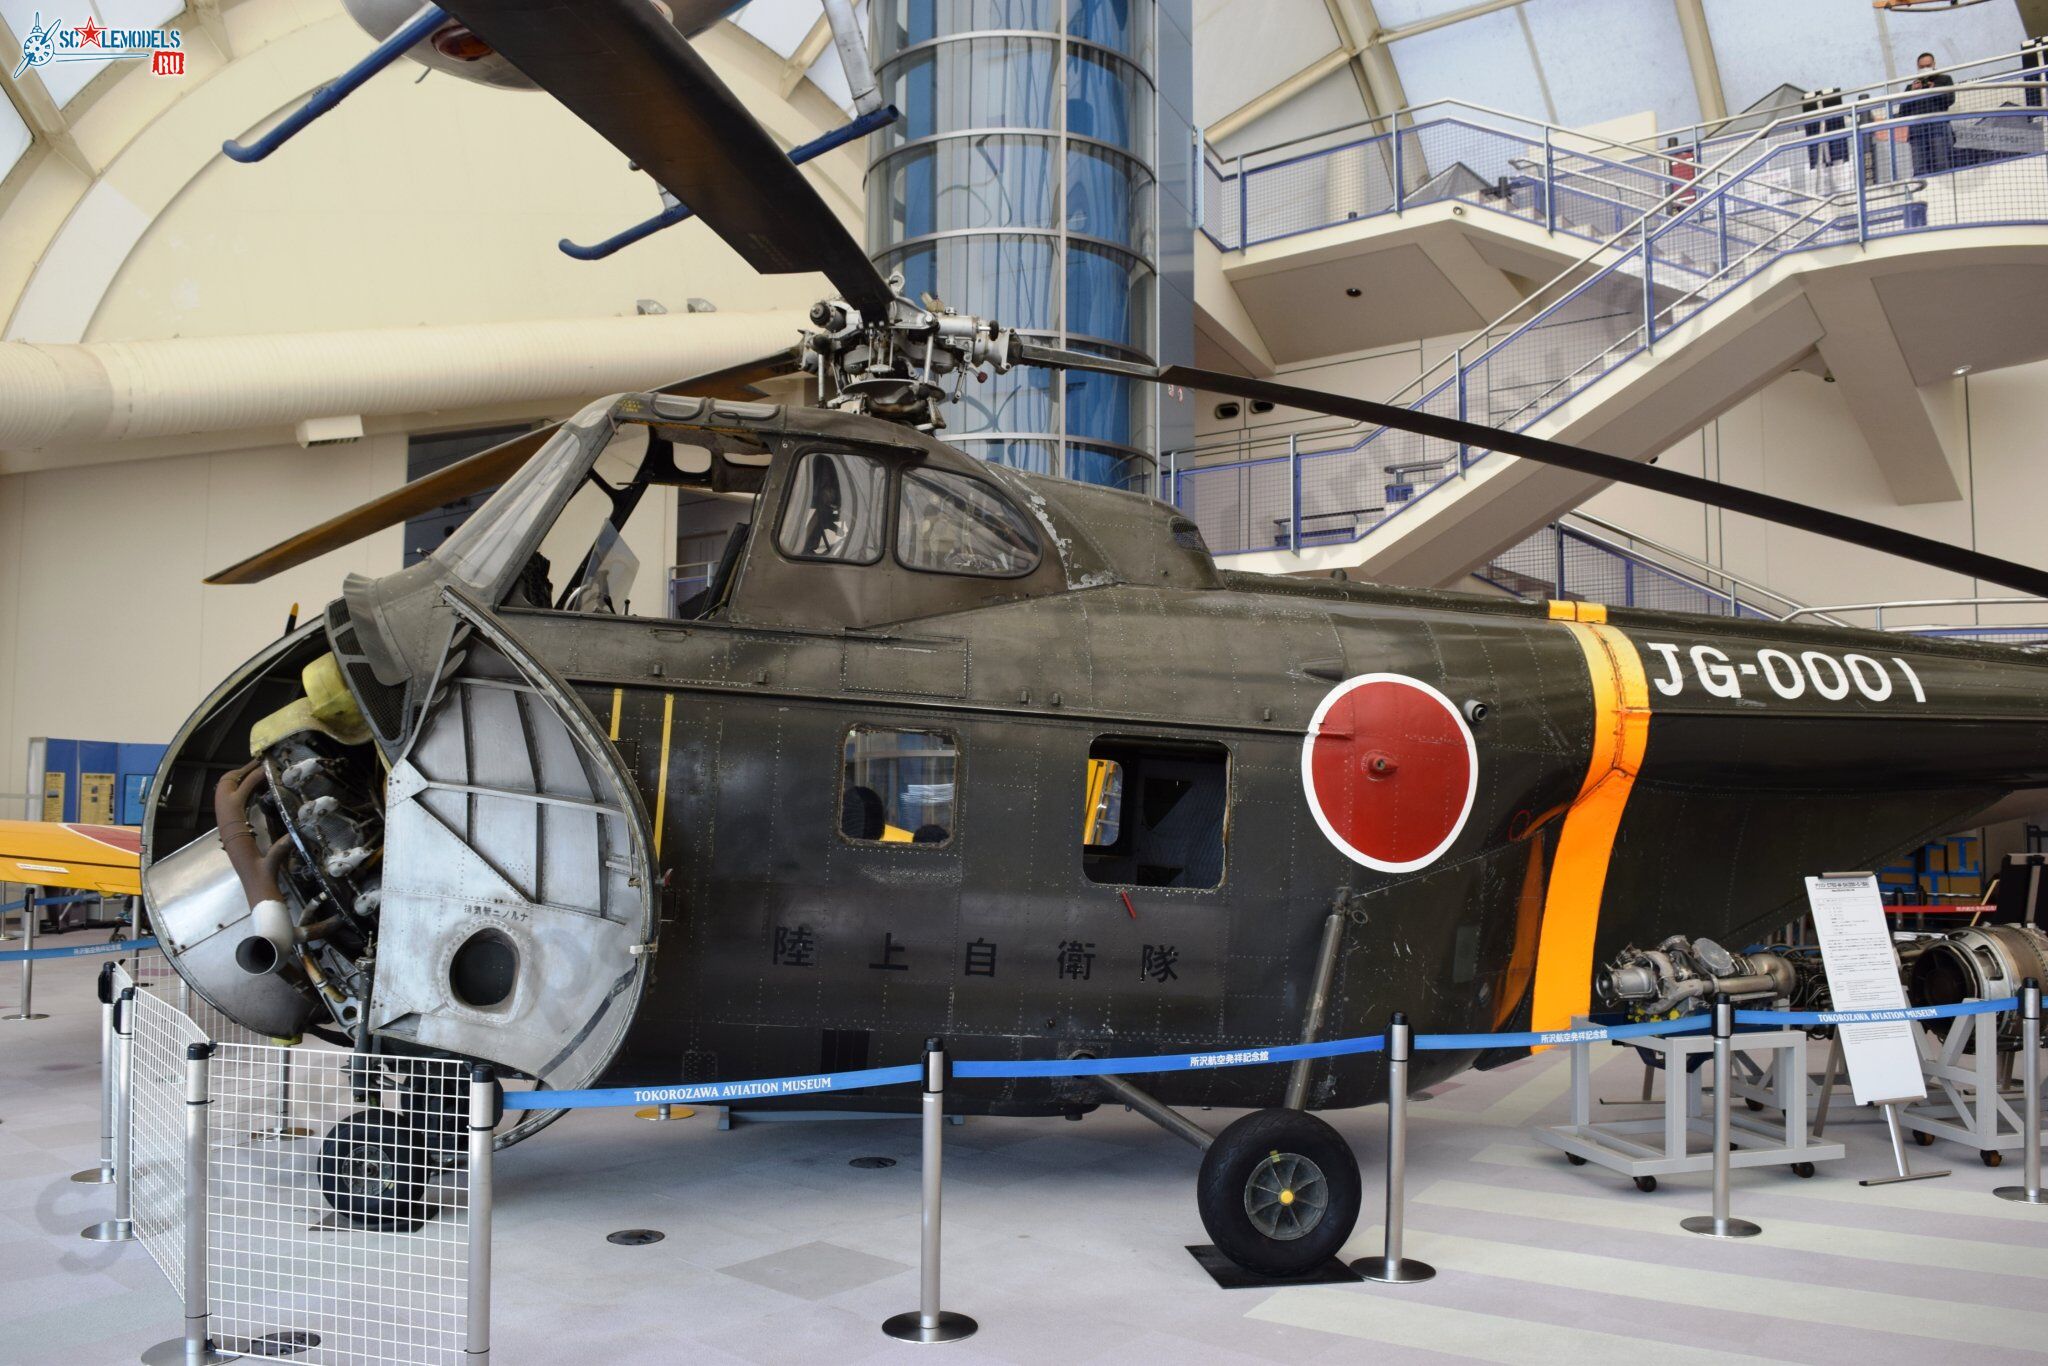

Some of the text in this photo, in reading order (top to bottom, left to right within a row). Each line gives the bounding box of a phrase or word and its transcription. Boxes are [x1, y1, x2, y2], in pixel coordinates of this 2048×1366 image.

[1647, 642, 1927, 703] JG-0001
[1818, 1008, 1938, 1023] TOKOROZAWA AVIATION MUSEUM
[1190, 1051, 1269, 1067] 所沢航空発祥記念館
[634, 1077, 832, 1102] TOKOROZAWA AVIATION MUSEUM
